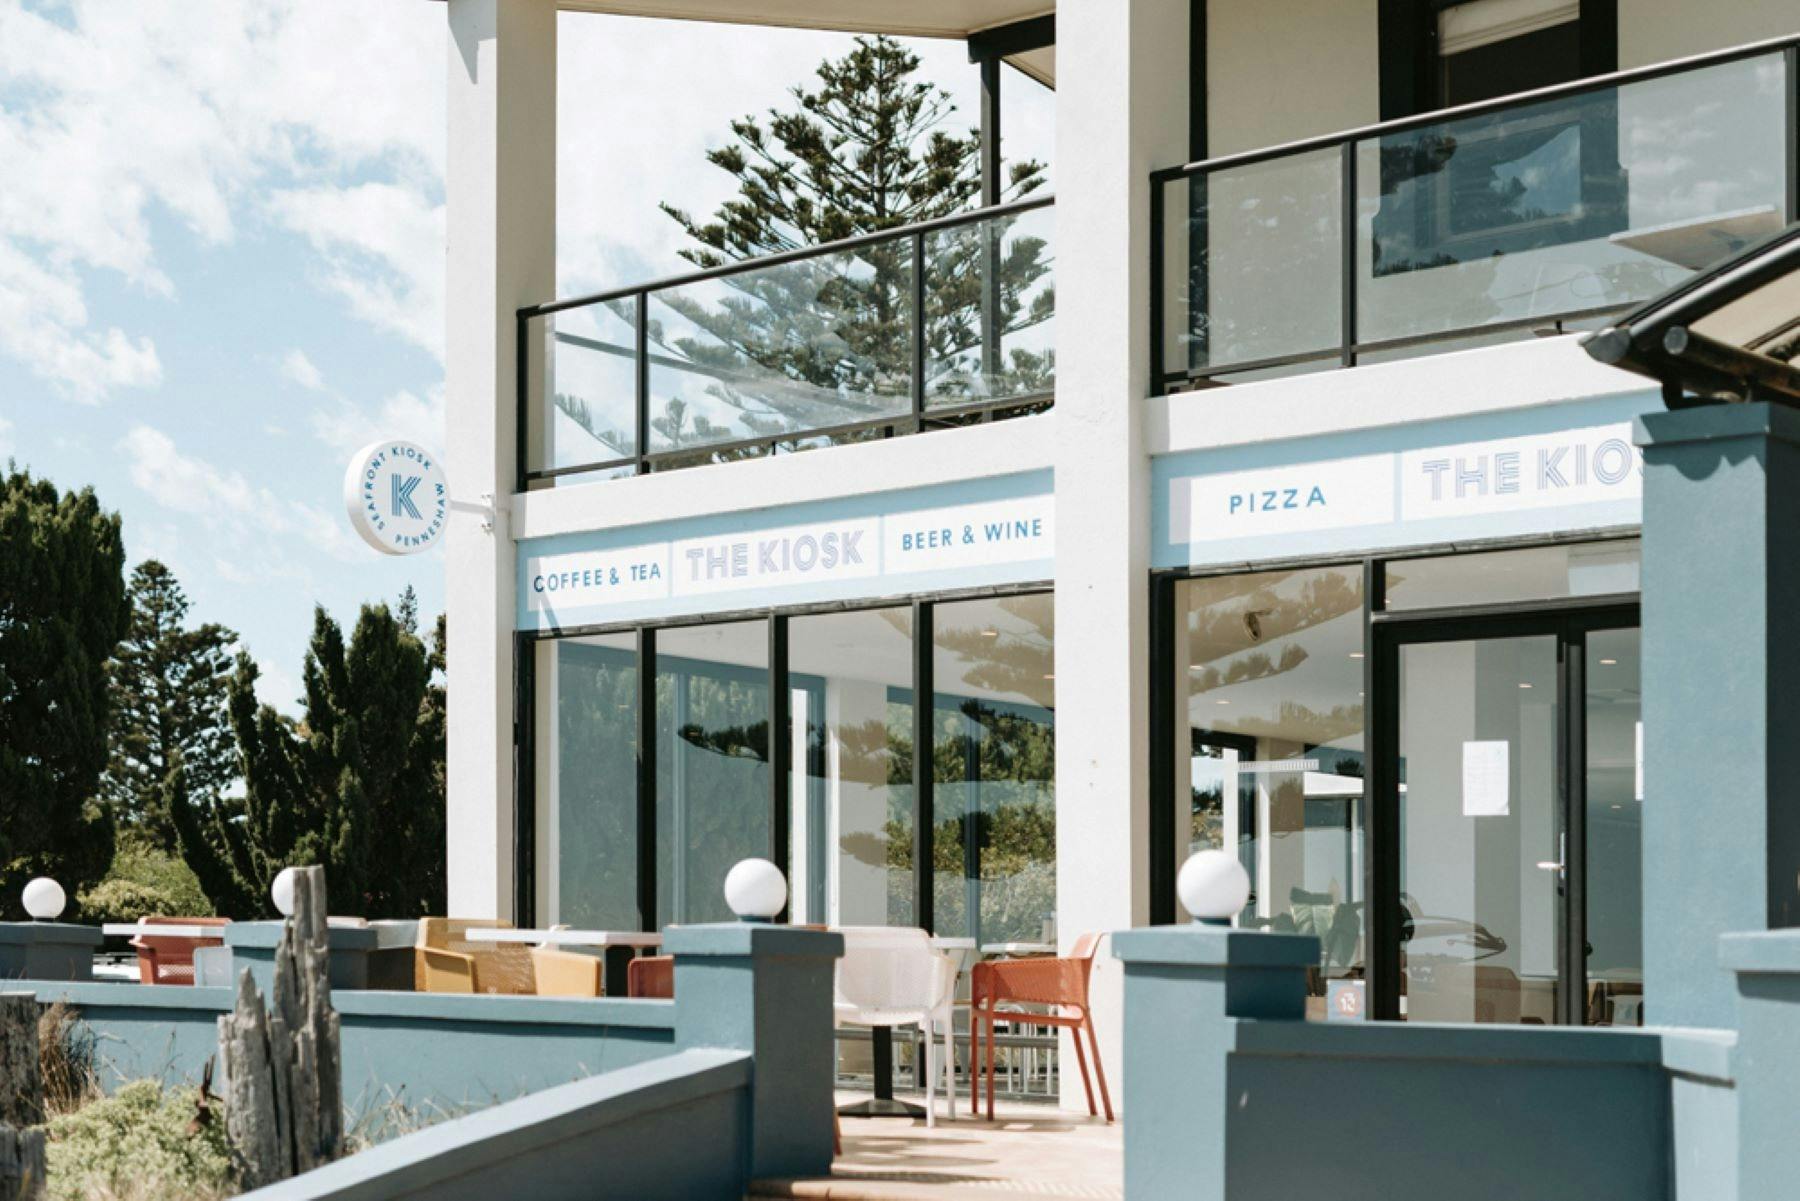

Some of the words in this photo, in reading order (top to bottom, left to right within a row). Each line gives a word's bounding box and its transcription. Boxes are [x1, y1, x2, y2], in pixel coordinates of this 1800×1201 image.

[364, 452, 386, 531] SEAFRONT
[391, 446, 432, 470] KIOSK
[1422, 451, 1520, 500] THE
[1536, 437, 1642, 491] KIO
[391, 472, 423, 521] K
[394, 482, 445, 546] PENNESHAW
[1229, 485, 1327, 515] PIZZA
[686, 542, 748, 581] THE
[757, 529, 864, 574] KIOSK
[902, 528, 953, 551] BEER
[961, 524, 975, 544] &
[984, 518, 1043, 542] WINE
[533, 568, 603, 593] COFFEE
[609, 567, 620, 586] &
[631, 562, 662, 582] TEA
